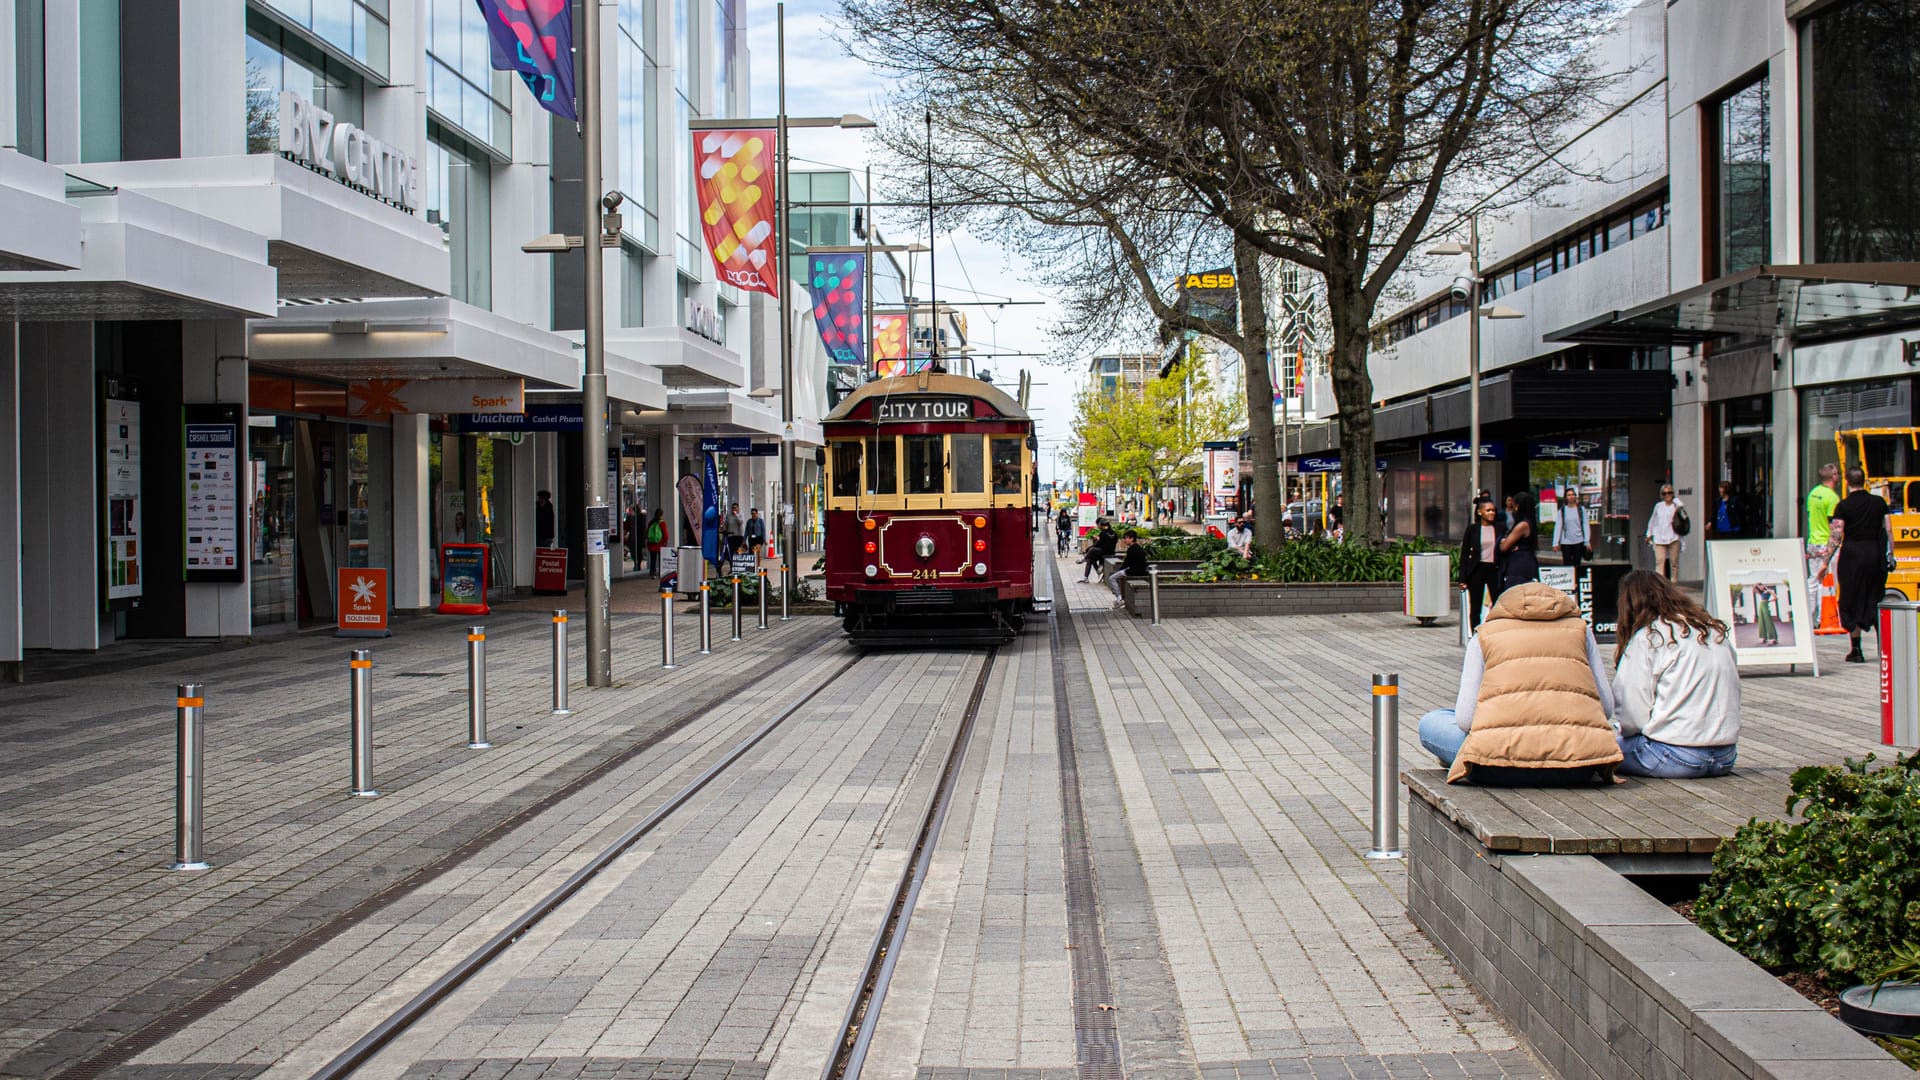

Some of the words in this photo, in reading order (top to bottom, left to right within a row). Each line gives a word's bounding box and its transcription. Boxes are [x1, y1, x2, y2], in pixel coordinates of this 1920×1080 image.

[279, 91, 335, 176] BNZ
[334, 123, 417, 211] CENTRE
[1186, 273, 1235, 289] ASB
[472, 396, 507, 409] Spark
[879, 402, 917, 418] CITY
[920, 402, 969, 418] TOUR
[472, 413, 524, 424] Unichem
[532, 415, 558, 424] Cashel
[558, 415, 586, 424] Pharm
[702, 442, 718, 451] bnz
[541, 559, 561, 567] Postal
[912, 569, 938, 580] 244
[353, 603, 372, 612] Spark
[1595, 622, 1618, 633] OPE
[1881, 651, 1889, 704] Litter
